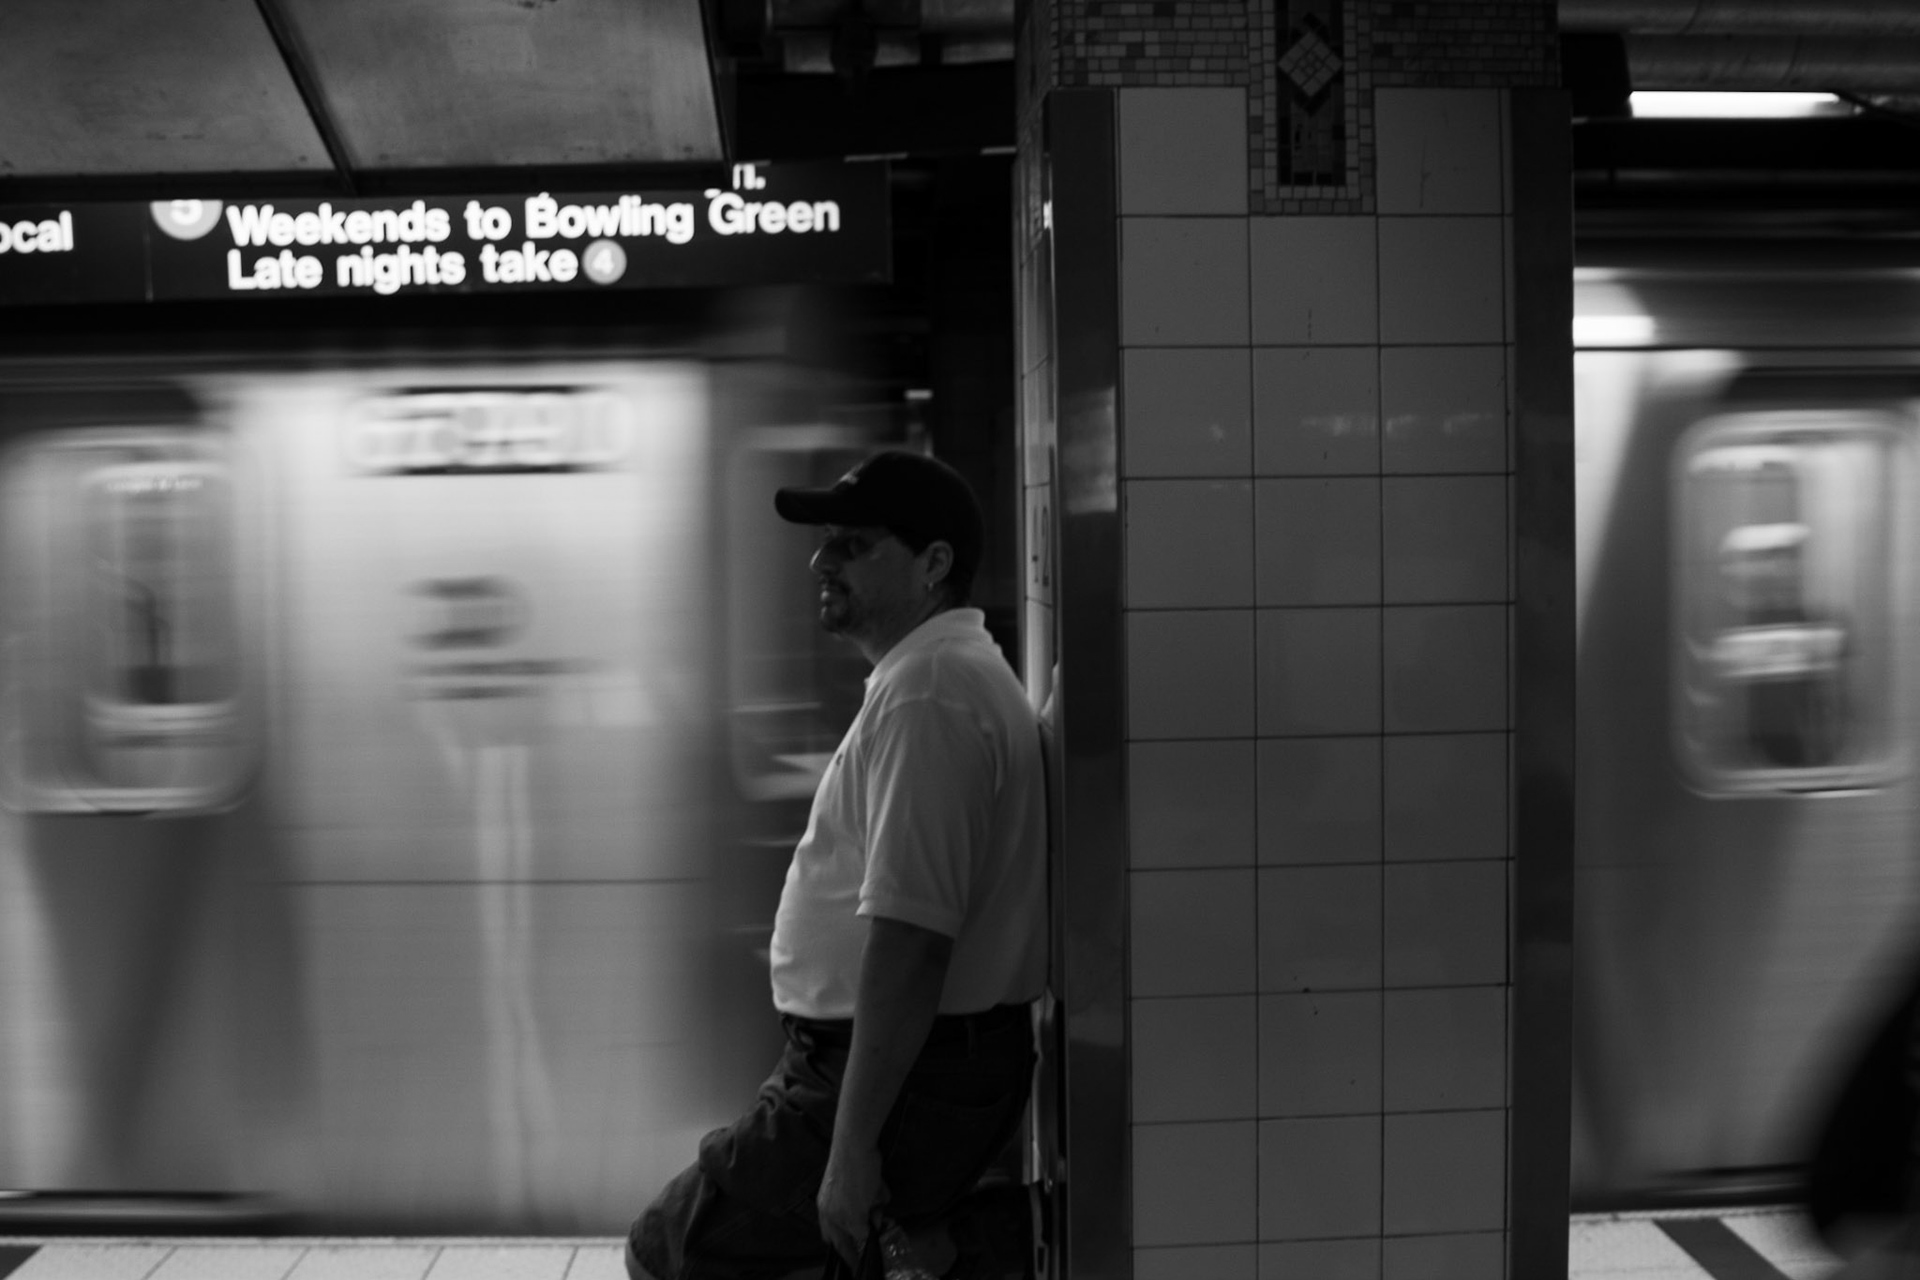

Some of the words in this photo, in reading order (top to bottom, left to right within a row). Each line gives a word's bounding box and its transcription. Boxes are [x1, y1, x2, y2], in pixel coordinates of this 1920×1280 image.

[226, 200, 451, 247] Weekends
[463, 200, 512, 241] to
[524, 194, 695, 245] Bowling
[707, 191, 841, 236] Green
[227, 248, 324, 290] Late
[336, 244, 467, 295] nights
[478, 240, 579, 284] take
